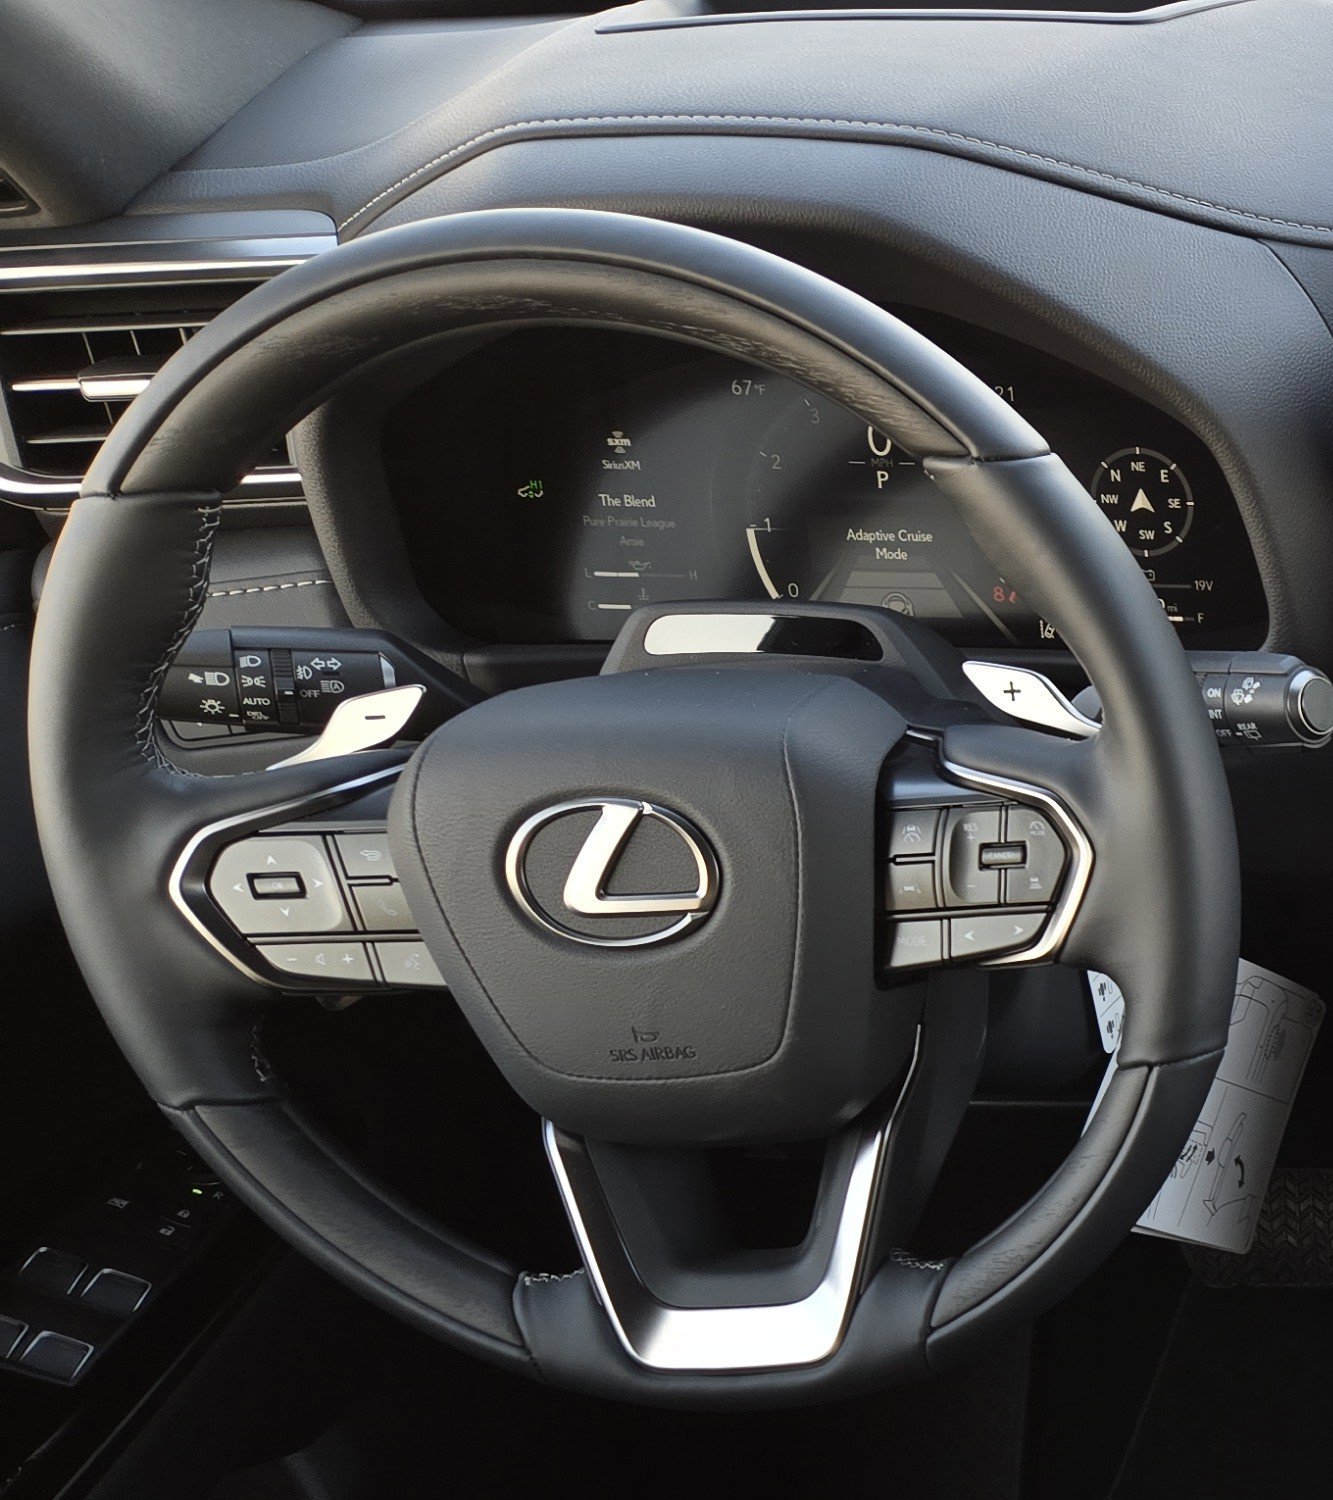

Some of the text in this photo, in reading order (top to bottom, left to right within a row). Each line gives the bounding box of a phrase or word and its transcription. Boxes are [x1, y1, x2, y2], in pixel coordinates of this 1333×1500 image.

[811, 410, 821, 425] 3
[601, 459, 641, 471] SiriusXM
[771, 454, 782, 469] 2
[869, 457, 894, 468] MPH
[1130, 461, 1146, 472] NE
[876, 471, 889, 489] P
[1110, 469, 1122, 483] N
[1160, 469, 1170, 483] E
[598, 493, 656, 509] The Blend
[1101, 494, 1119, 505] NW
[1168, 498, 1182, 509] SE
[582, 515, 676, 531] Pure Prairie League
[1114, 519, 1128, 533] W
[1163, 521, 1173, 534] S
[619, 535, 645, 547] Amie
[846, 528, 933, 544] Adaptive Cruise
[1139, 529, 1156, 541] SW
[875, 548, 908, 561] Mode
[787, 582, 799, 598] 0
[1194, 580, 1214, 592] 19V
[1197, 612, 1204, 623] F
[299, 689, 320, 698] OFF
[1206, 687, 1222, 698] ON
[243, 697, 271, 706] AUTO
[1208, 709, 1223, 720] INT
[1236, 722, 1258, 730] REAR
[640, 1045, 697, 1062] AIRBAG
